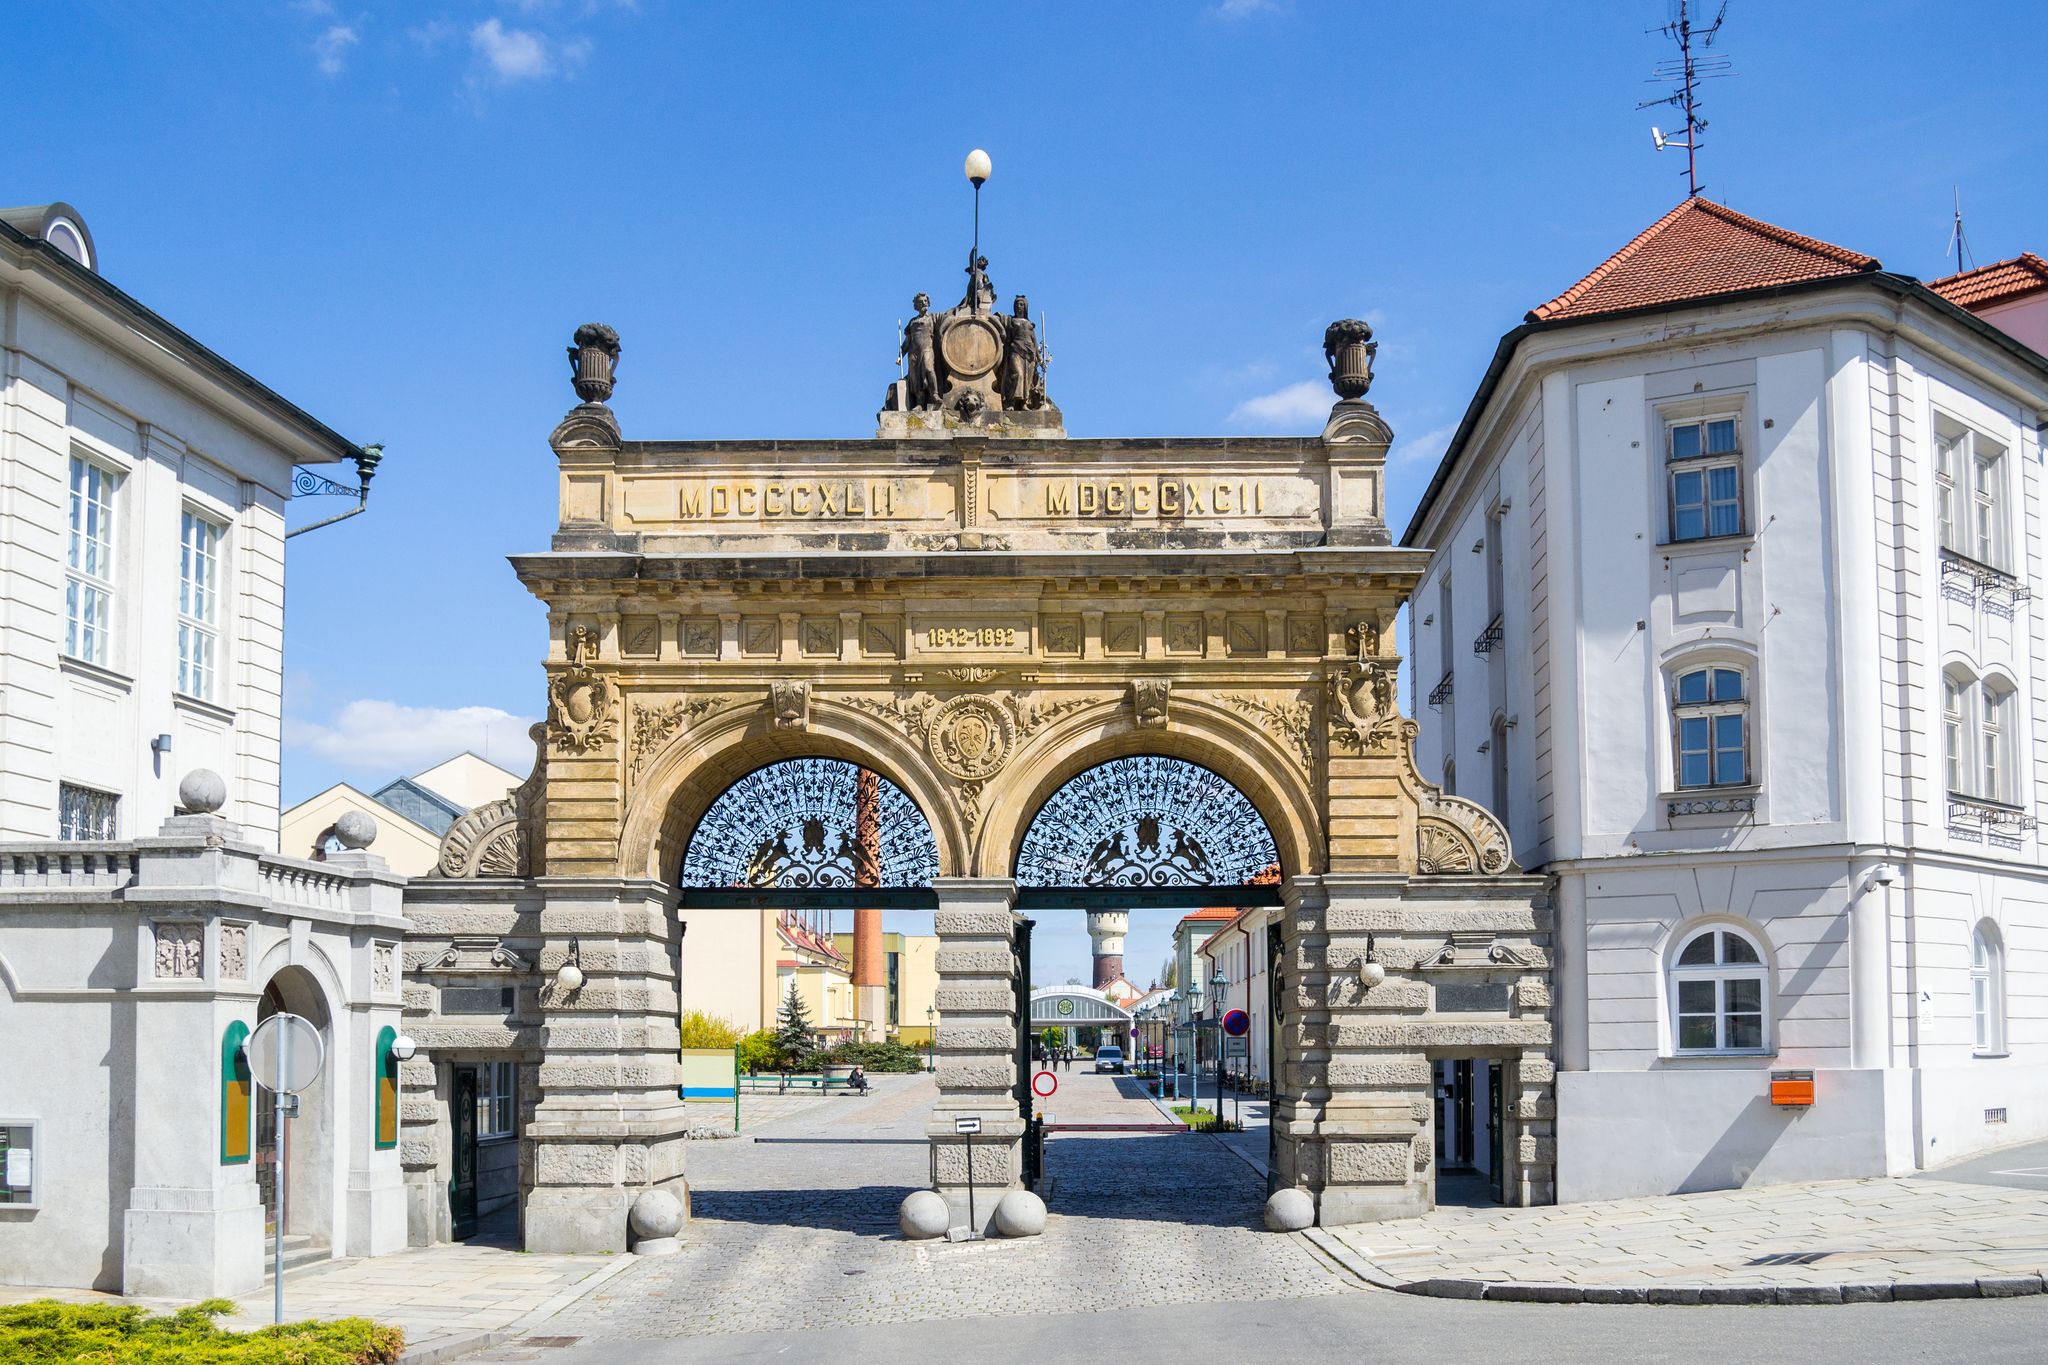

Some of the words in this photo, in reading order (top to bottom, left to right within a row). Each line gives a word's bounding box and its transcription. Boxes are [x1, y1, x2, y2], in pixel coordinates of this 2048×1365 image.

[681, 484, 895, 515] MDCCCXLII
[1048, 481, 1263, 513] MDCCCXCII
[928, 628, 1015, 645] 1842-1892
